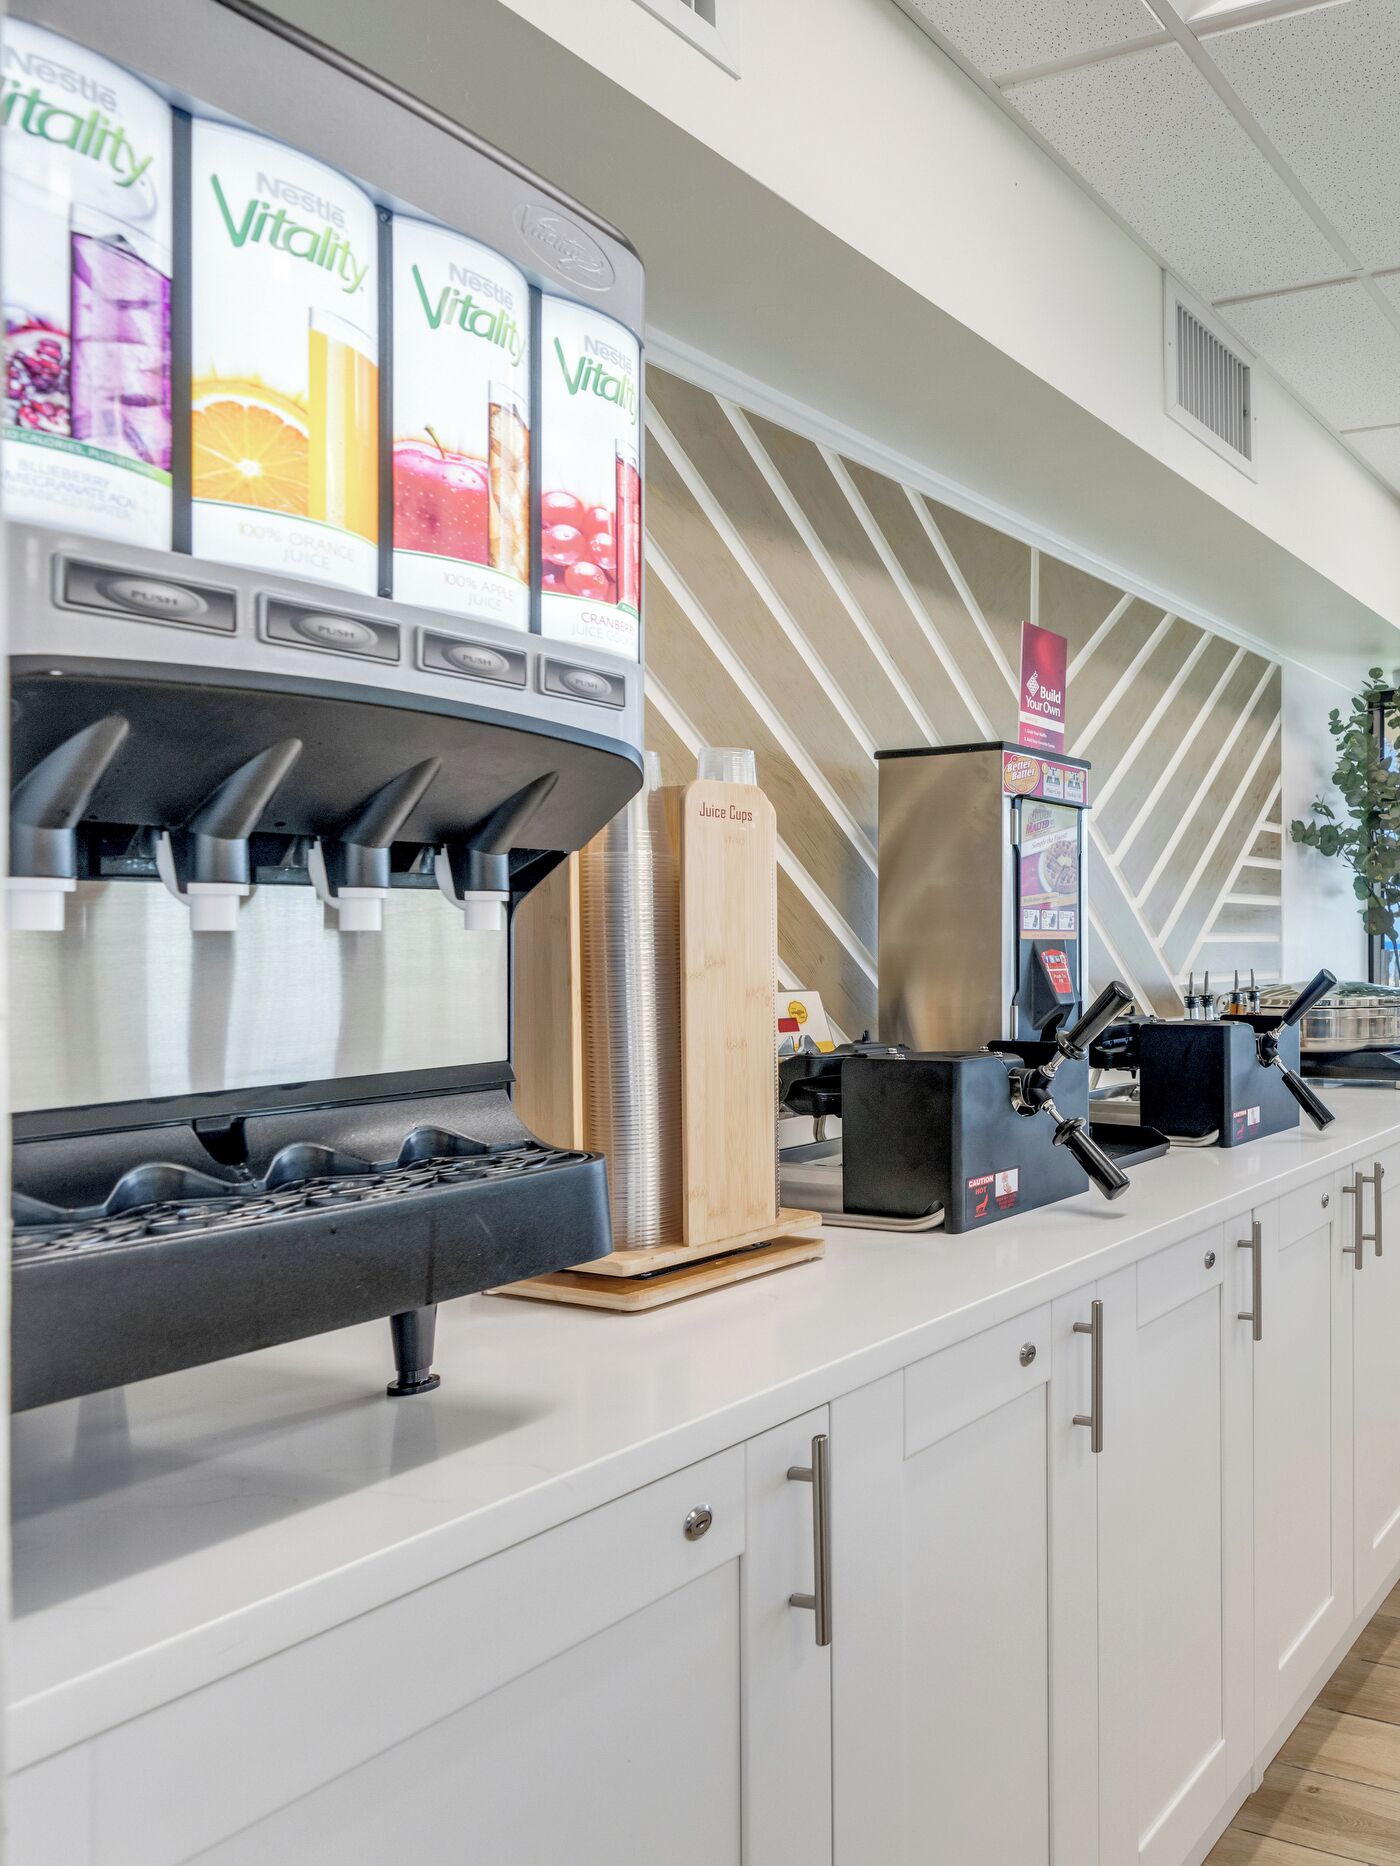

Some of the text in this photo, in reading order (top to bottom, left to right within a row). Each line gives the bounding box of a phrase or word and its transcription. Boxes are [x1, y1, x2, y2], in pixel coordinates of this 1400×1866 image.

[0, 75, 153, 188] itality
[210, 173, 368, 294] Vitality
[412, 264, 526, 367] Vitality
[553, 337, 638, 426] Vitality
[18, 459, 111, 488] BLUEBERRY
[239, 521, 355, 563] 100% ORANGE
[282, 548, 330, 569] JUICE
[131, 590, 178, 606] PUSH
[481, 580, 514, 601] APPLE
[468, 592, 502, 612] JUICE
[317, 624, 355, 639] PUSH
[462, 653, 492, 666] PUSH
[574, 678, 599, 690] PUSH
[1040, 686, 1061, 704] Build
[1025, 695, 1061, 717] Your Own
[1007, 760, 1031, 773] Better
[1011, 768, 1035, 781] Batter
[699, 802, 753, 824] Juice Cups
[1026, 820, 1050, 835] MALTED
[968, 1174, 994, 1189] CAUTION
[975, 1186, 987, 1195] HOT
